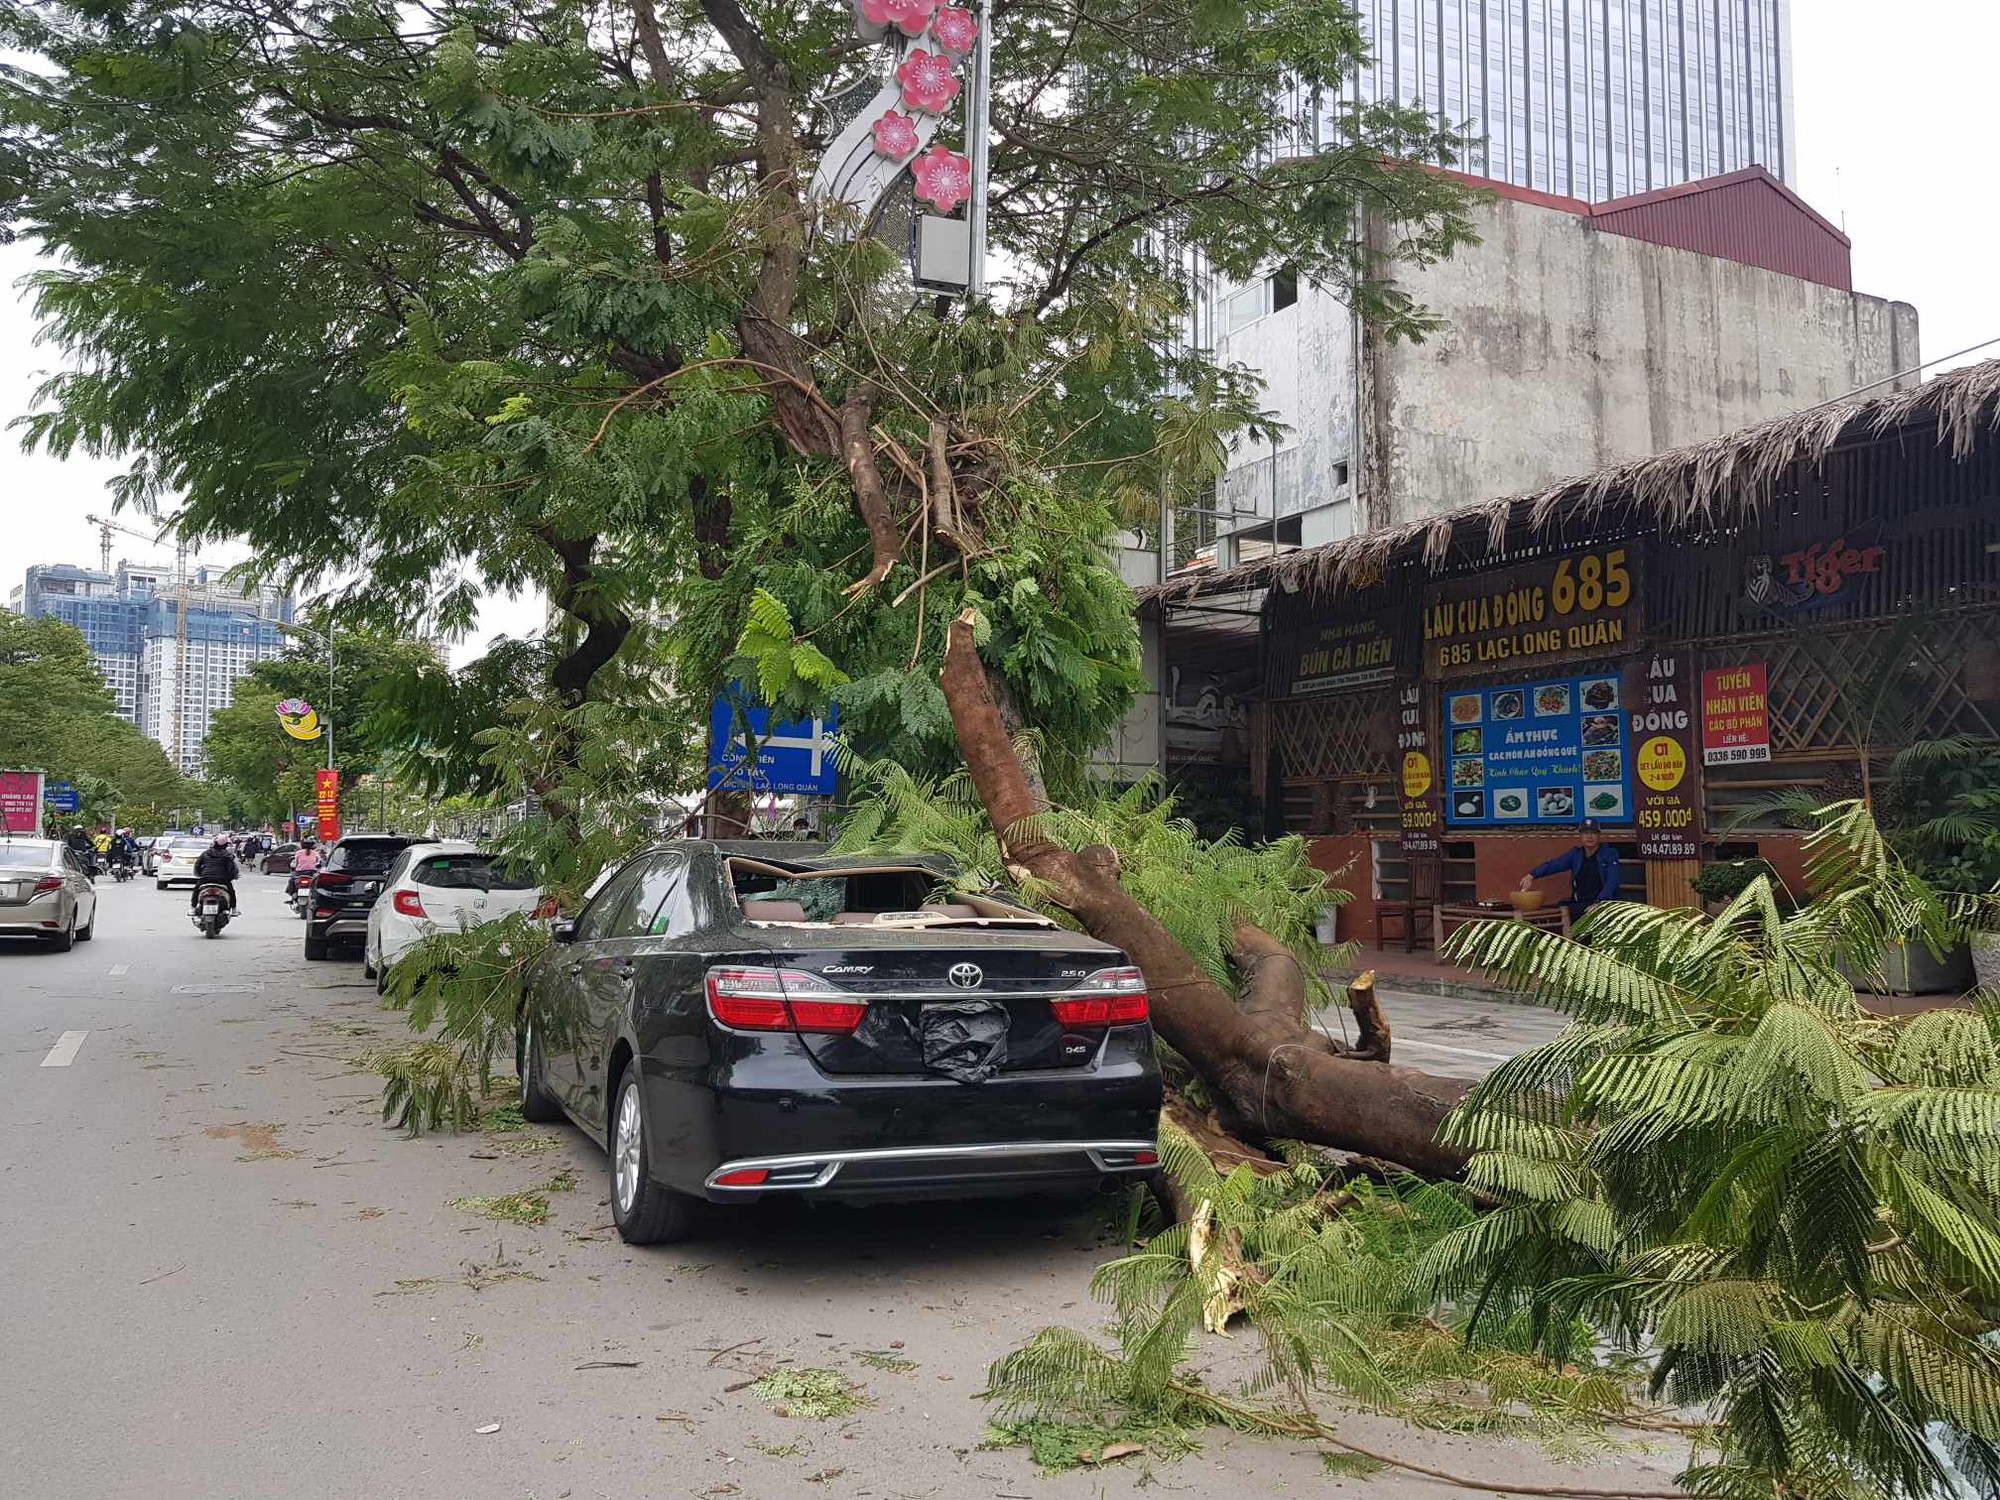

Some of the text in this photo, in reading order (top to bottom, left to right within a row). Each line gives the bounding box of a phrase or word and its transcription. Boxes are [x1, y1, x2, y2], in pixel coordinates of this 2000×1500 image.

[1780, 538, 1884, 595] Tiger
[1458, 598, 1489, 635] CUA
[1552, 549, 1631, 615] 685
[1440, 643, 1471, 667] 685
[1511, 629, 1561, 656] LONG
[1568, 619, 1623, 649] QUÂN
[1706, 692, 1764, 715] NHÂN VIÊN
[1730, 749, 1747, 761] 590
[1749, 748, 1767, 759] 999
[796, 783, 818, 791] QUÂN
